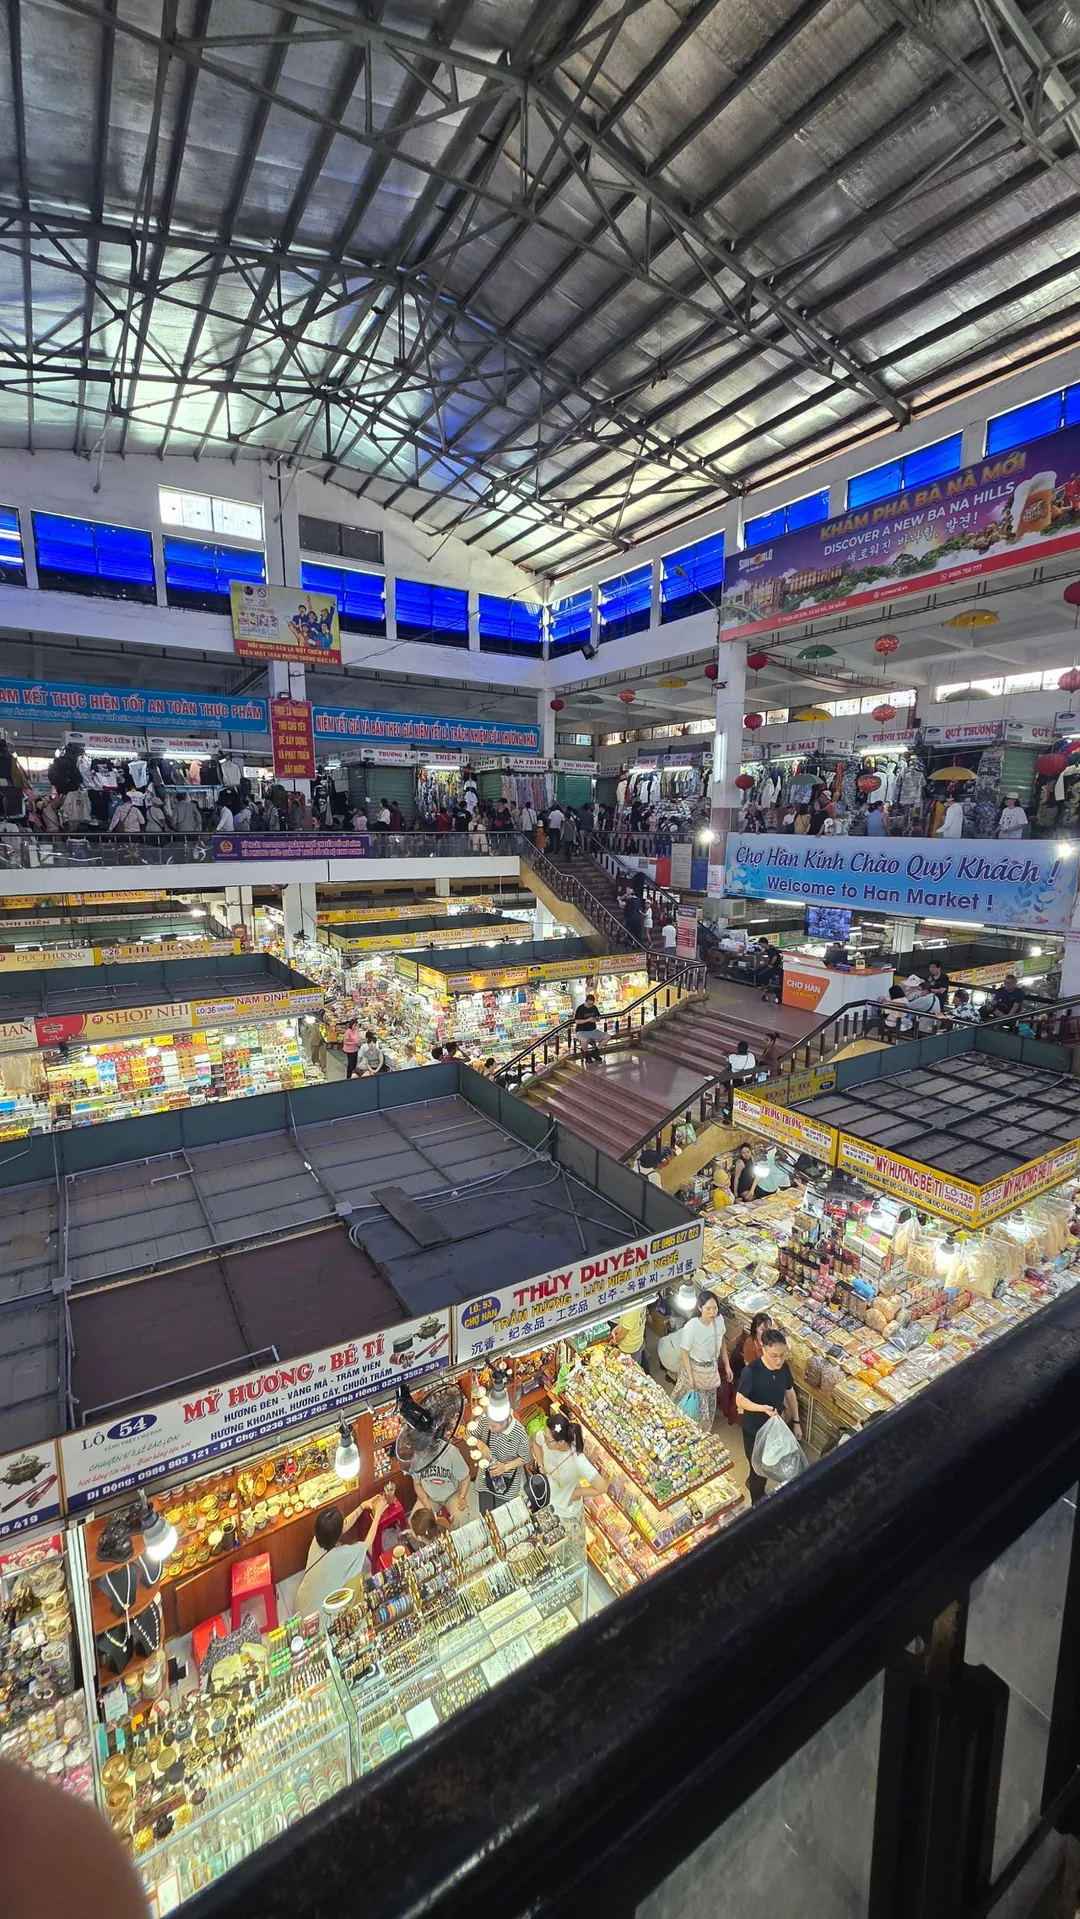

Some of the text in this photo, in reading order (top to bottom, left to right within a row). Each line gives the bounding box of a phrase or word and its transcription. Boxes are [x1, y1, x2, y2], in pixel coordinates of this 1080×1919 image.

[820, 451, 1027, 543] KHÁM PHÁ BÀ NÀ MỚI
[823, 481, 1016, 556] DISCOVER A NEW BA NA HILLS
[945, 511, 979, 534] 발견!
[0, 685, 264, 720] AM KẾT THỰC HIỆN TỐT AN TOÀN THỰC PHẨM
[315, 712, 335, 733] NIÊM
[335, 712, 348, 734] YẾT
[348, 715, 361, 734] GIÁ
[360, 716, 371, 736] VÀ
[370, 717, 385, 737] BÁN
[384, 721, 401, 738] THEO
[402, 720, 413, 739] GIÁ
[413, 720, 430, 740] NIÊM
[430, 720, 441, 740] YẾT
[442, 722, 449, 740] LÀ
[450, 724, 470, 742] TRÁCH
[470, 726, 489, 746] NHIỆM
[798, 741, 815, 750] MAI
[944, 725, 962, 739] QUÝ
[735, 845, 1063, 885] Chợ Hàn Kính Chào Quý Khách !
[766, 874, 994, 913] Welcome to Han Market !
[109, 948, 120, 956] 26
[128, 942, 204, 955] THU TRANG
[236, 996, 260, 1005] NAM
[263, 992, 289, 1004] ĐỊNH
[786, 979, 821, 994] CHỢ HÀN
[106, 1008, 154, 1025] SHOP
[157, 1002, 188, 1017] NHI
[738, 1100, 748, 1112] 136
[875, 1153, 888, 1173] MỸ
[888, 1160, 919, 1188] HƯƠNG
[919, 1171, 932, 1194] BÉ
[944, 1195, 959, 1206] CHỢ
[945, 1184, 974, 1203] LÔ:135
[513, 1244, 648, 1307] THÙY DUYÊN
[531, 1292, 572, 1318] HƯƠNG
[583, 1279, 605, 1298] LƯU
[607, 1268, 632, 1289] NIỆM
[634, 1260, 651, 1278] MỸ
[653, 1249, 680, 1271] NGHỆ
[598, 1287, 617, 1307] 진주
[667, 1257, 694, 1277] 기념품
[464, 1308, 498, 1328] CHỢ HÀN
[482, 1299, 493, 1310] 53
[471, 1299, 589, 1356] 沉香 纪念品 工艺品
[183, 1333, 386, 1424] MỸ HƯƠNG BÉ TÍ
[224, 1403, 258, 1423] HƯƠNG
[287, 1385, 312, 1400] VÀNG
[361, 1359, 382, 1373] VIÊN
[81, 1416, 147, 1451] LÔ 54
[210, 1423, 244, 1441] HƯƠNG
[289, 1395, 320, 1412] HƯƠNG
[102, 1476, 135, 1496] Động:
[137, 1465, 165, 1481] 0986
[168, 1457, 189, 1469] 803
[191, 1448, 209, 1460] 121
[220, 1439, 234, 1450] ĐT
[235, 1431, 258, 1444] Chợ:
[259, 1420, 283, 1434] 0236
[286, 1410, 309, 1425] 3837
[310, 1403, 328, 1415] 262
[335, 1394, 353, 1406] Nhà
[355, 1385, 380, 1400] riêng:
[381, 1376, 402, 1389] 0236
[0, 1514, 38, 1535] 6 419
